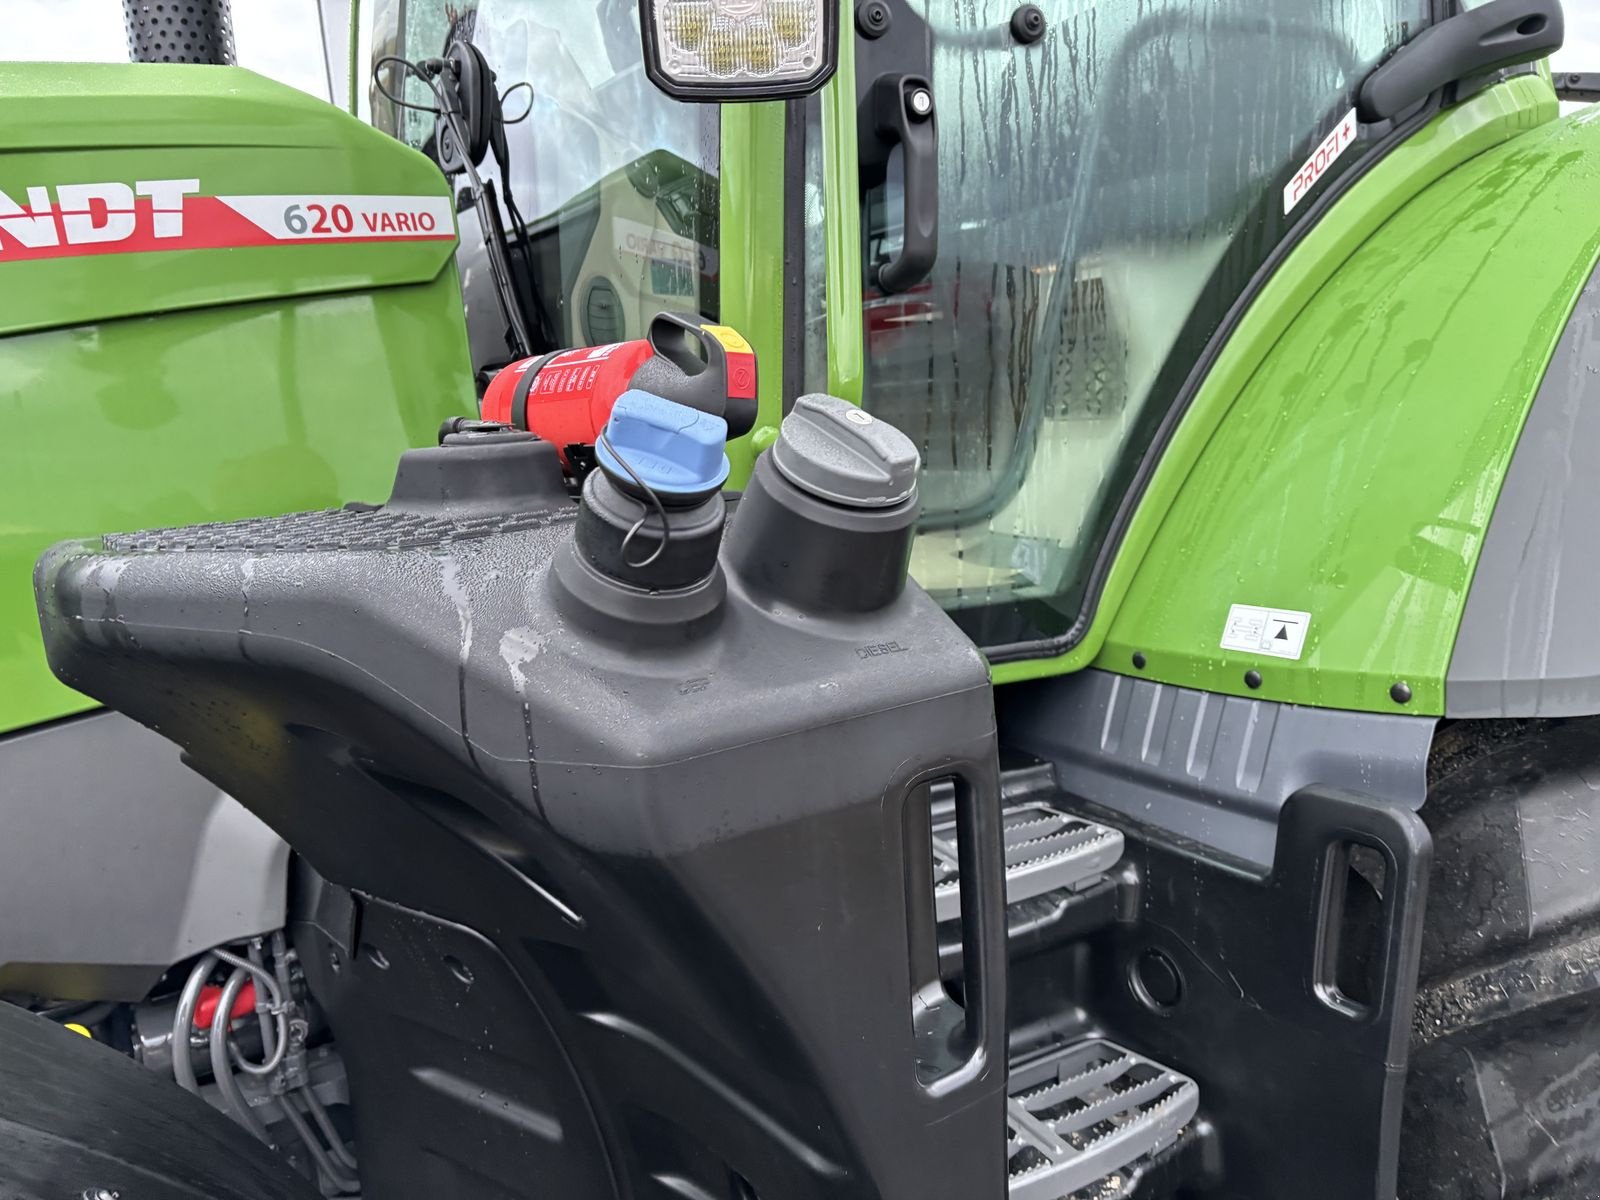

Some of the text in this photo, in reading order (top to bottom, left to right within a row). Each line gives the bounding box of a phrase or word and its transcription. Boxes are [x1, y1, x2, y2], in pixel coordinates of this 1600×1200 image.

[1293, 131, 1339, 201] PROFI
[284, 203, 436, 235] 620 VARIO
[855, 640, 909, 659] DIESEL
